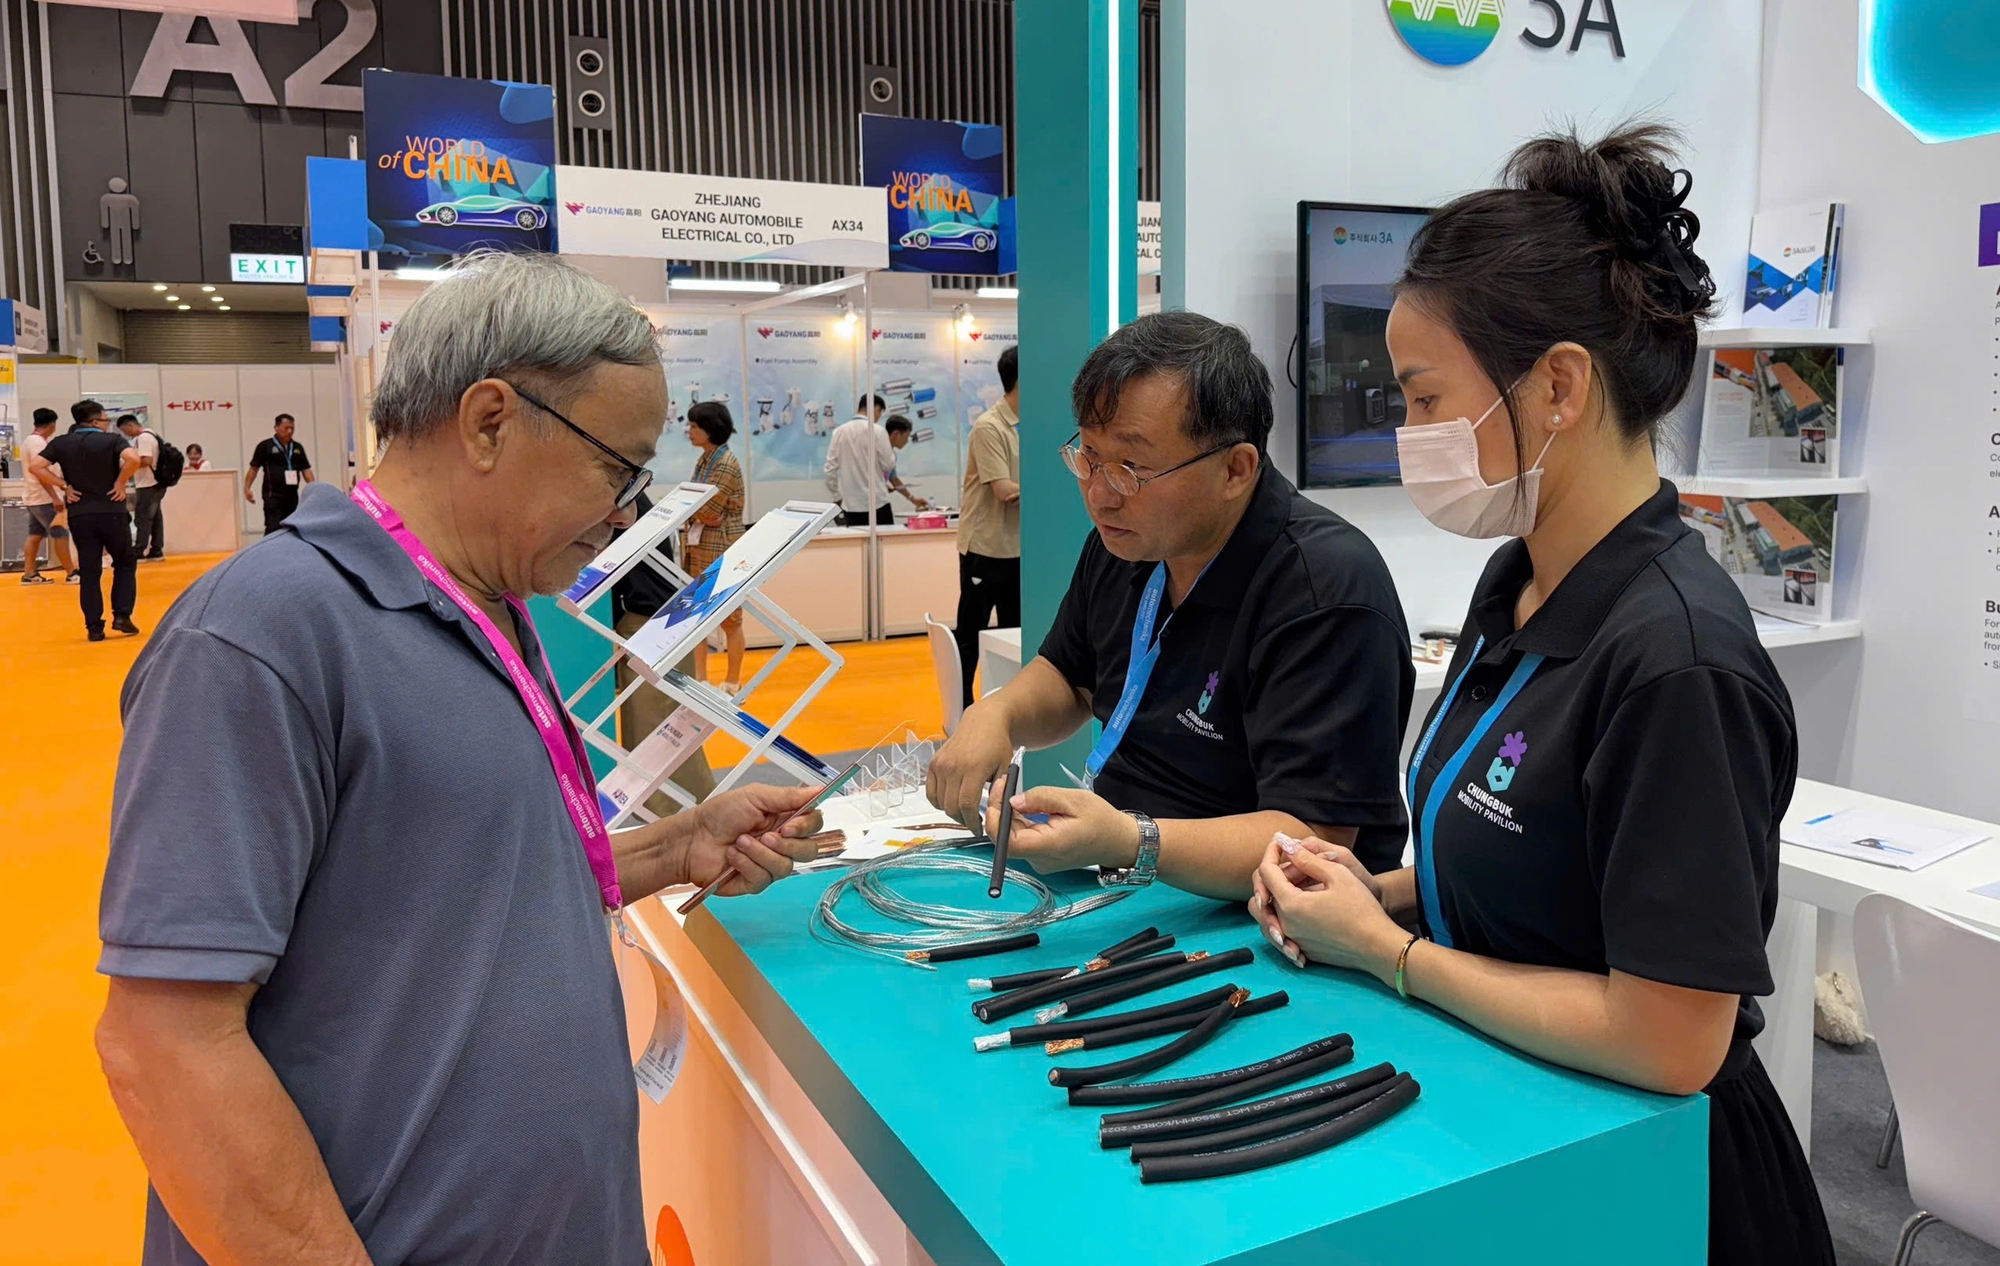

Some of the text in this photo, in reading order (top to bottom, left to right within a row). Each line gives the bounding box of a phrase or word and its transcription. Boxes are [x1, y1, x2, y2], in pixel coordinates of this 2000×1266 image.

[130, 0, 378, 111] A2
[406, 135, 486, 158] WORLD
[378, 151, 516, 185] of CHINA
[892, 170, 952, 190] WORLD
[695, 193, 761, 208] ZHEJIANG
[890, 184, 974, 213] CHINA
[586, 206, 625, 216] GAOYANG
[651, 208, 803, 228] GAOYANG AUTOMOBILE
[832, 220, 864, 232] AX34
[662, 228, 794, 246] ELECTRICAL CO., LTD
[1379, 232, 1393, 244] 3A
[238, 259, 296, 274] EXIT
[184, 400, 215, 411] EXIT
[416, 553, 478, 615] automechanika
[1138, 588, 1158, 642] automechanika
[508, 658, 551, 728] automechanika
[1111, 684, 1138, 729] automechanika
[1176, 712, 1224, 740] MOBILITY PAVILION
[1186, 708, 1214, 731] CHUNGBUK
[1412, 700, 1448, 766] automechanika
[560, 772, 595, 839] automechanika
[578, 791, 588, 804] CITY
[1467, 782, 1513, 818] CHUNGBUK
[1457, 790, 1523, 834] MOBILITY PAVILION
[1220, 1068, 1244, 1077] WCT
[1248, 1063, 1269, 1072] CCA
[1253, 1101, 1275, 1111] CCA
[1283, 1090, 1314, 1103] CABLE
[1226, 1107, 1250, 1117] WCT
[1102, 1125, 1128, 1134] 2023
